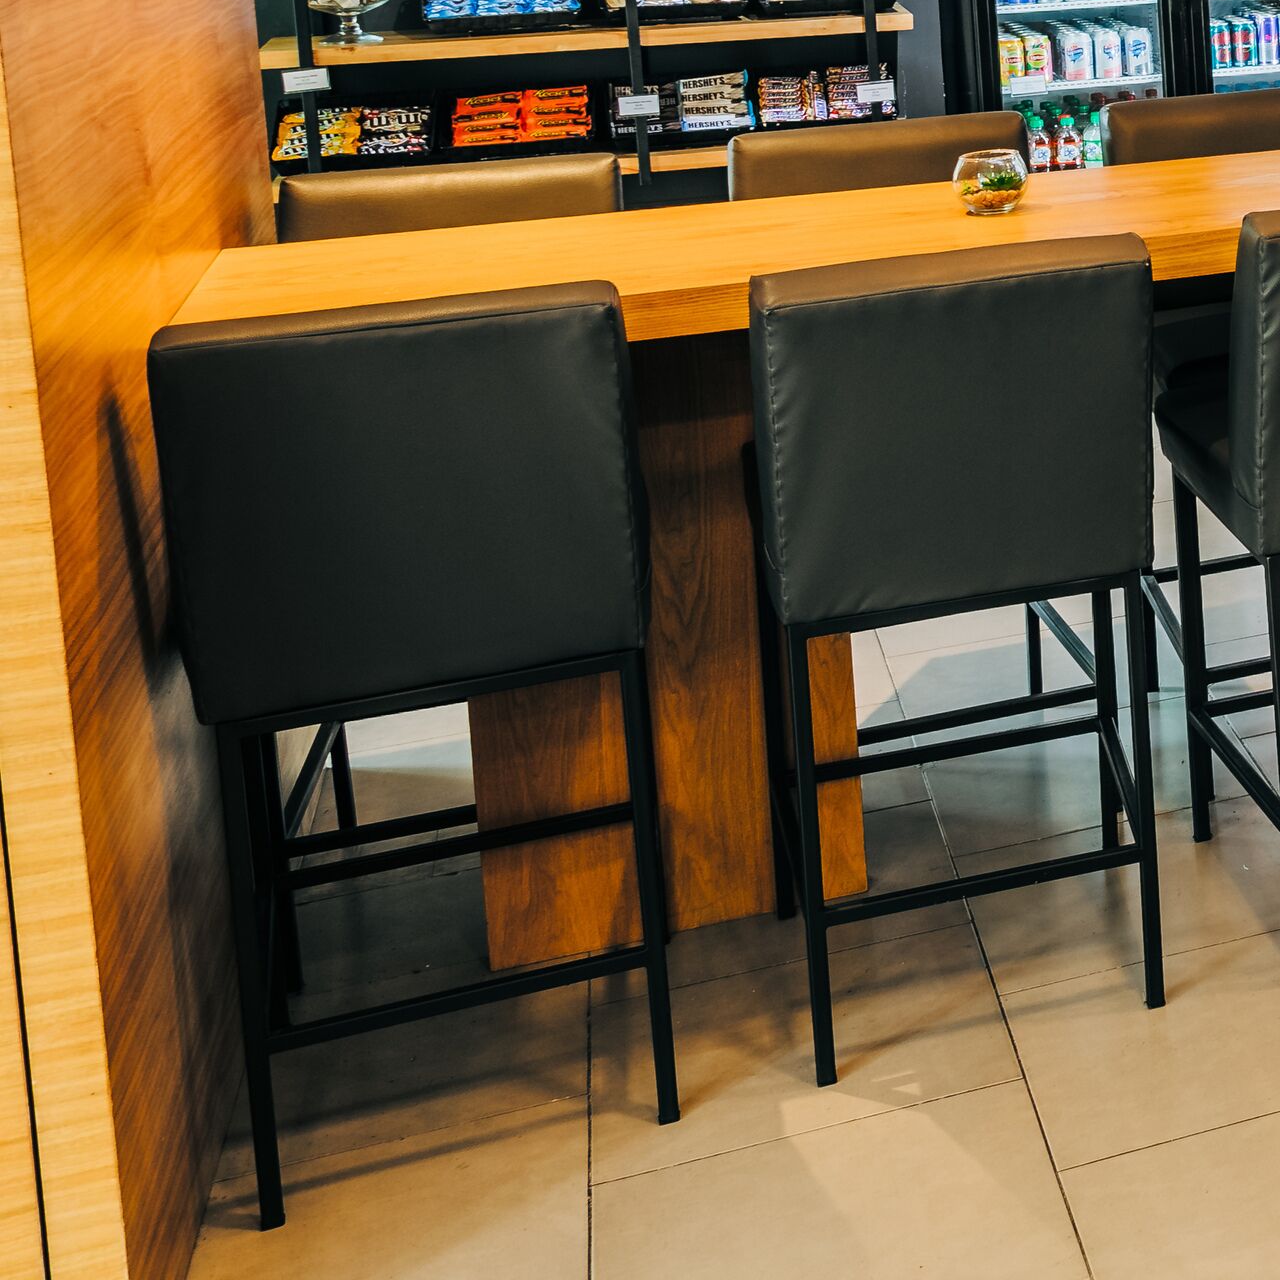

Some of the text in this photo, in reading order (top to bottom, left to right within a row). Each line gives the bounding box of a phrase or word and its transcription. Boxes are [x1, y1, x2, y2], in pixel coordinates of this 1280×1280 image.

[682, 76, 726, 89] HERSHEY'S
[682, 91, 726, 102] HERSHEY'S
[685, 105, 729, 115] HERSHEY'S
[687, 119, 732, 129] HERSHEY'S
